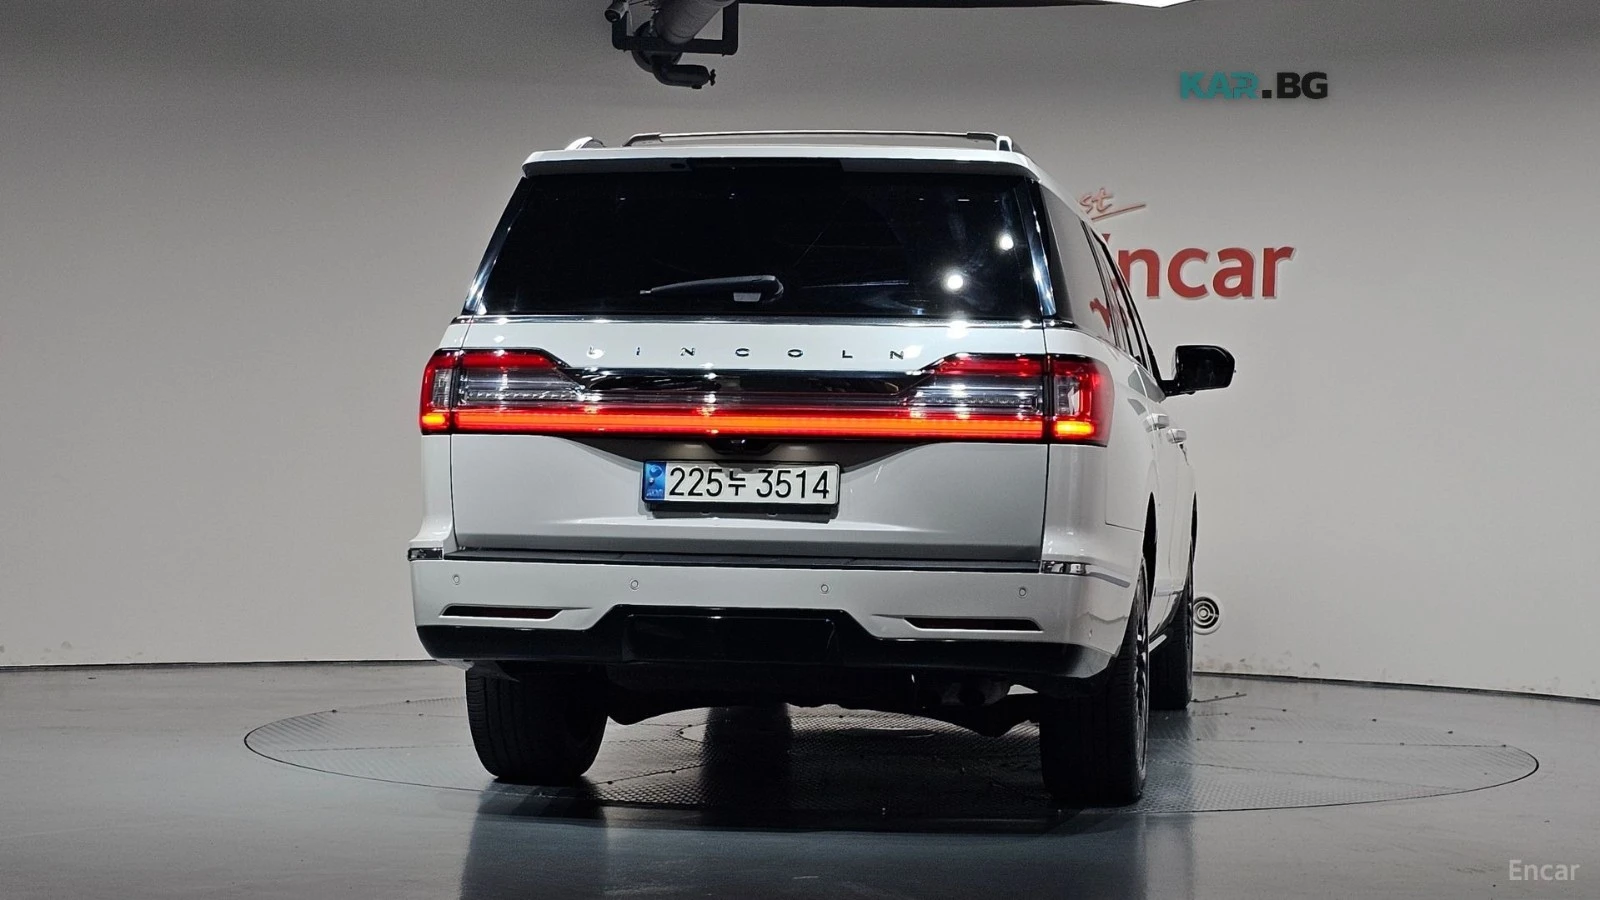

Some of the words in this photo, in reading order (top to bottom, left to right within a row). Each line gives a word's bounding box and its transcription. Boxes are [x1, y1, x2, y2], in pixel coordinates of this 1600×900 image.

[1101, 233, 1295, 299] ncar
[588, 346, 904, 360] LINCOLN
[756, 469, 830, 499] 3514
